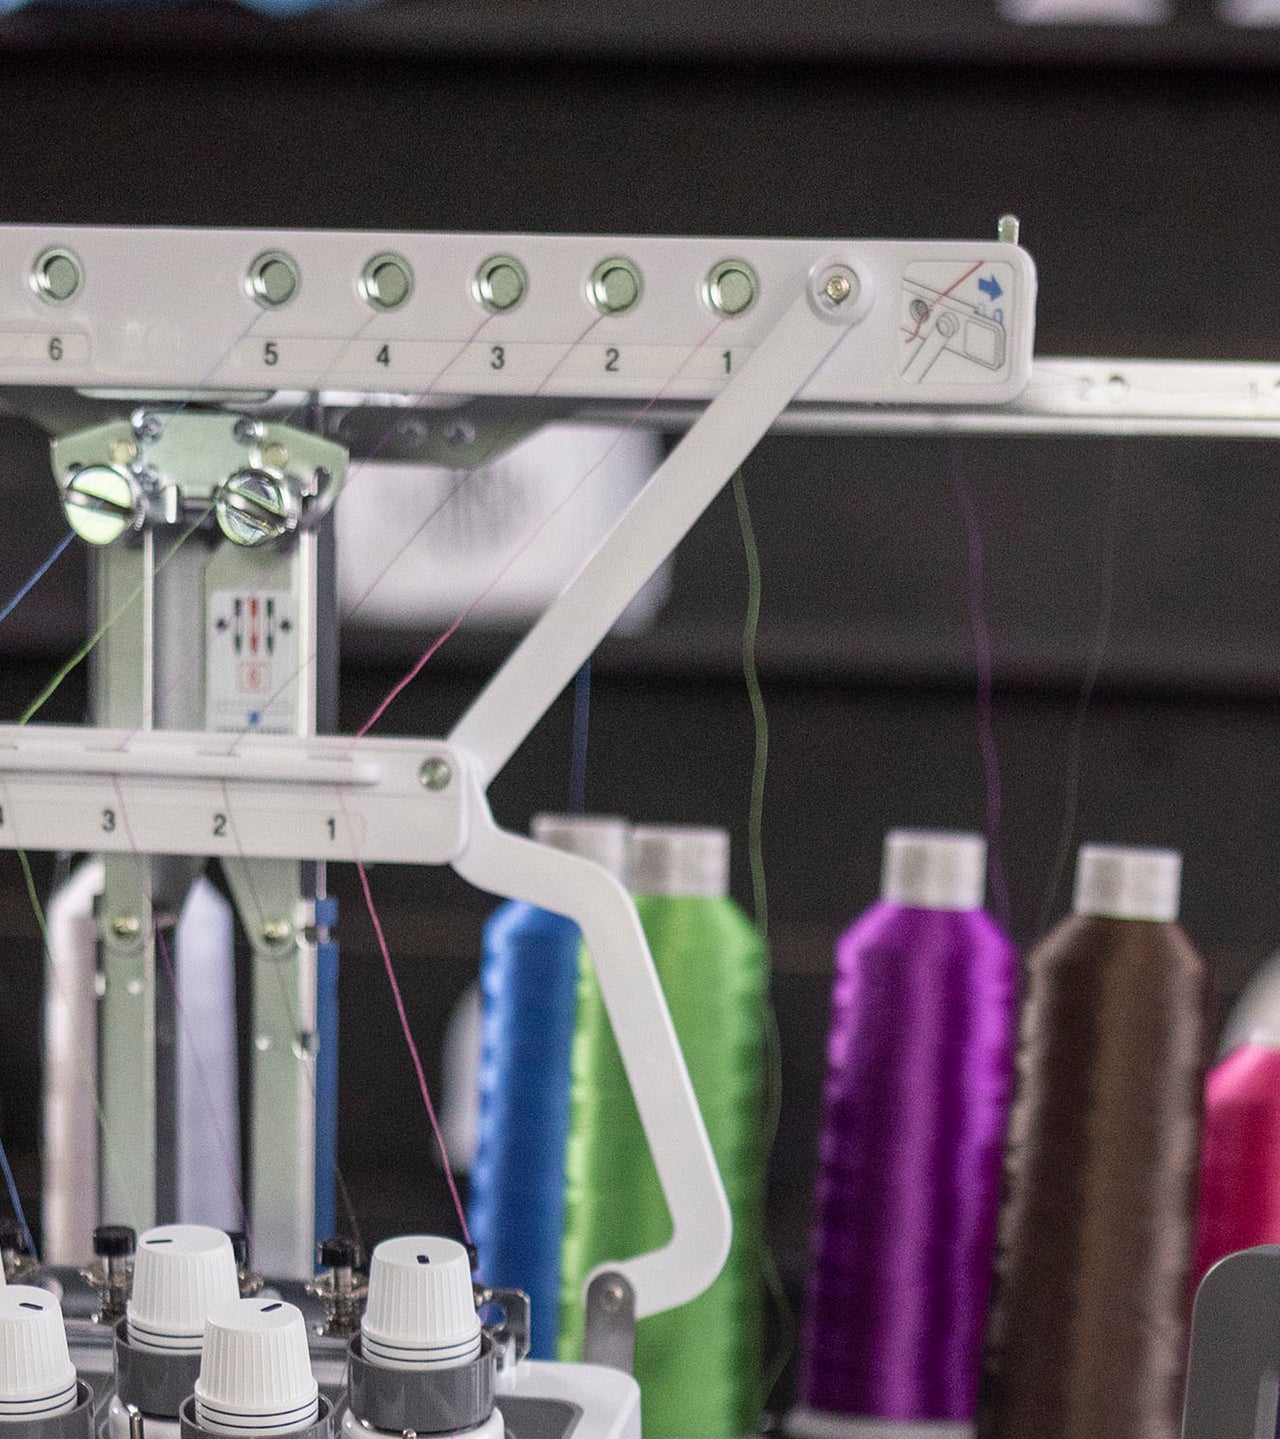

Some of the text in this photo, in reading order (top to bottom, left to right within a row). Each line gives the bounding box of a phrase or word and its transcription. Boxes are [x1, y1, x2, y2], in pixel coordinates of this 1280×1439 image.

[48, 337, 63, 361] 6
[264, 343, 732, 373] 5 4 3 2 1
[101, 808, 116, 832] 3
[212, 813, 227, 836] 2
[327, 817, 337, 841] 1
